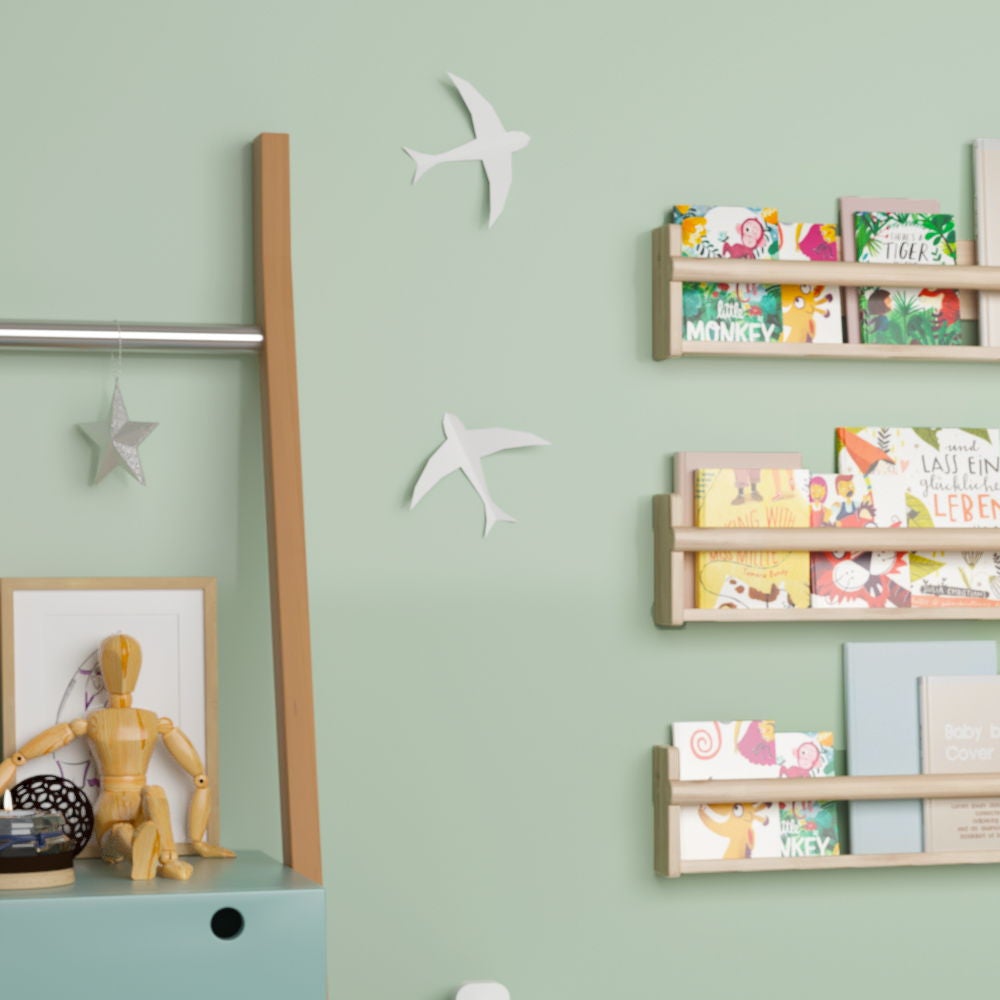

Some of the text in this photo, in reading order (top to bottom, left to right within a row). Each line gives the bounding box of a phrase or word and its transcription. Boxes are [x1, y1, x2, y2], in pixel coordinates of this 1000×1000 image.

[884, 241, 930, 262] TIGER
[687, 320, 775, 343] MONKEY
[945, 439, 980, 452] und
[921, 454, 958, 475] LASS
[944, 723, 983, 742] Baby
[945, 744, 995, 762] Cover
